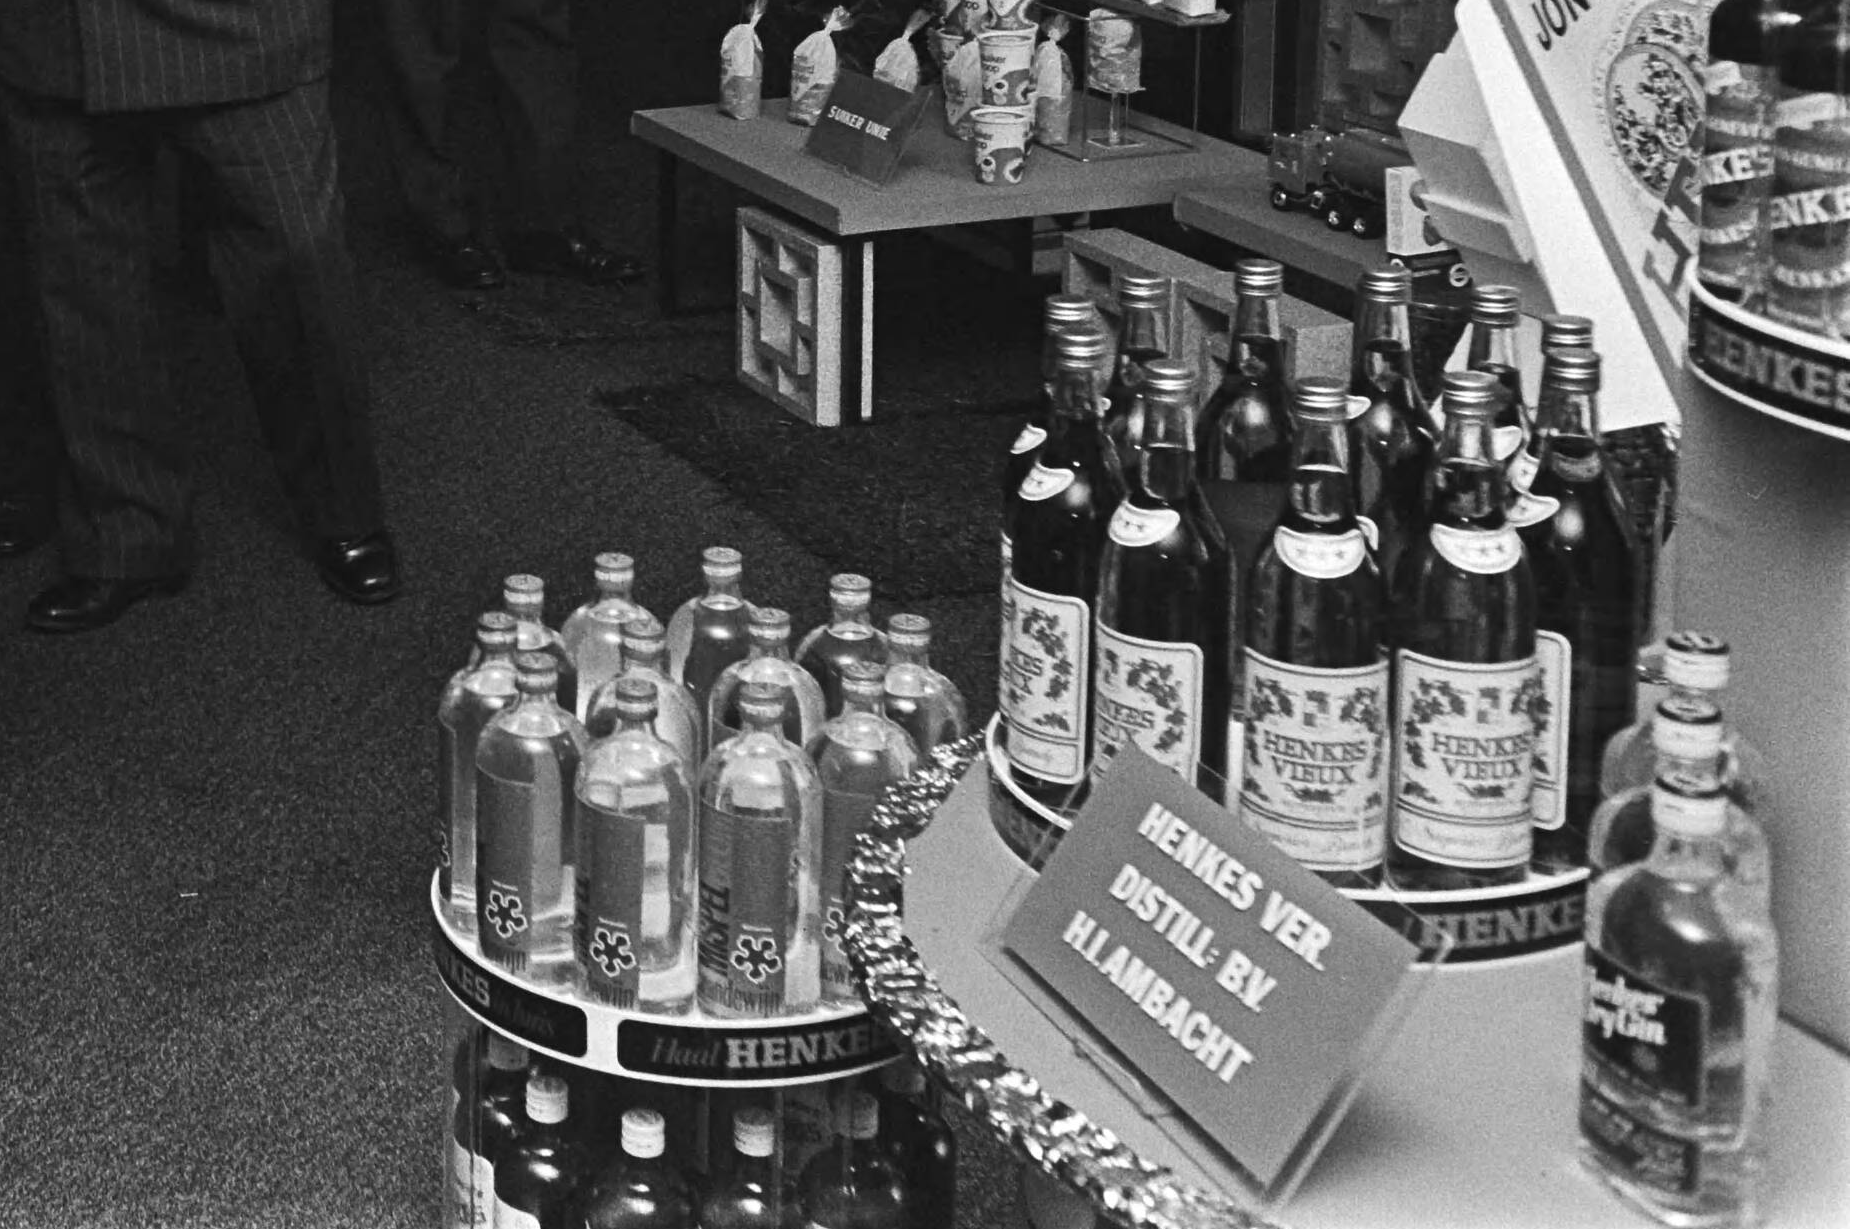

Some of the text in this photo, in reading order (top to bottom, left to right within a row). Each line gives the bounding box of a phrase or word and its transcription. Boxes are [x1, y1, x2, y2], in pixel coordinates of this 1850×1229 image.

[827, 105, 865, 130] SUIKER
[1262, 729, 1368, 762] HENKES
[1431, 731, 1534, 758] HENKES
[1271, 755, 1356, 785] VIEUX
[1440, 756, 1524, 780] VIEUX
[1137, 802, 1264, 912] HENKES
